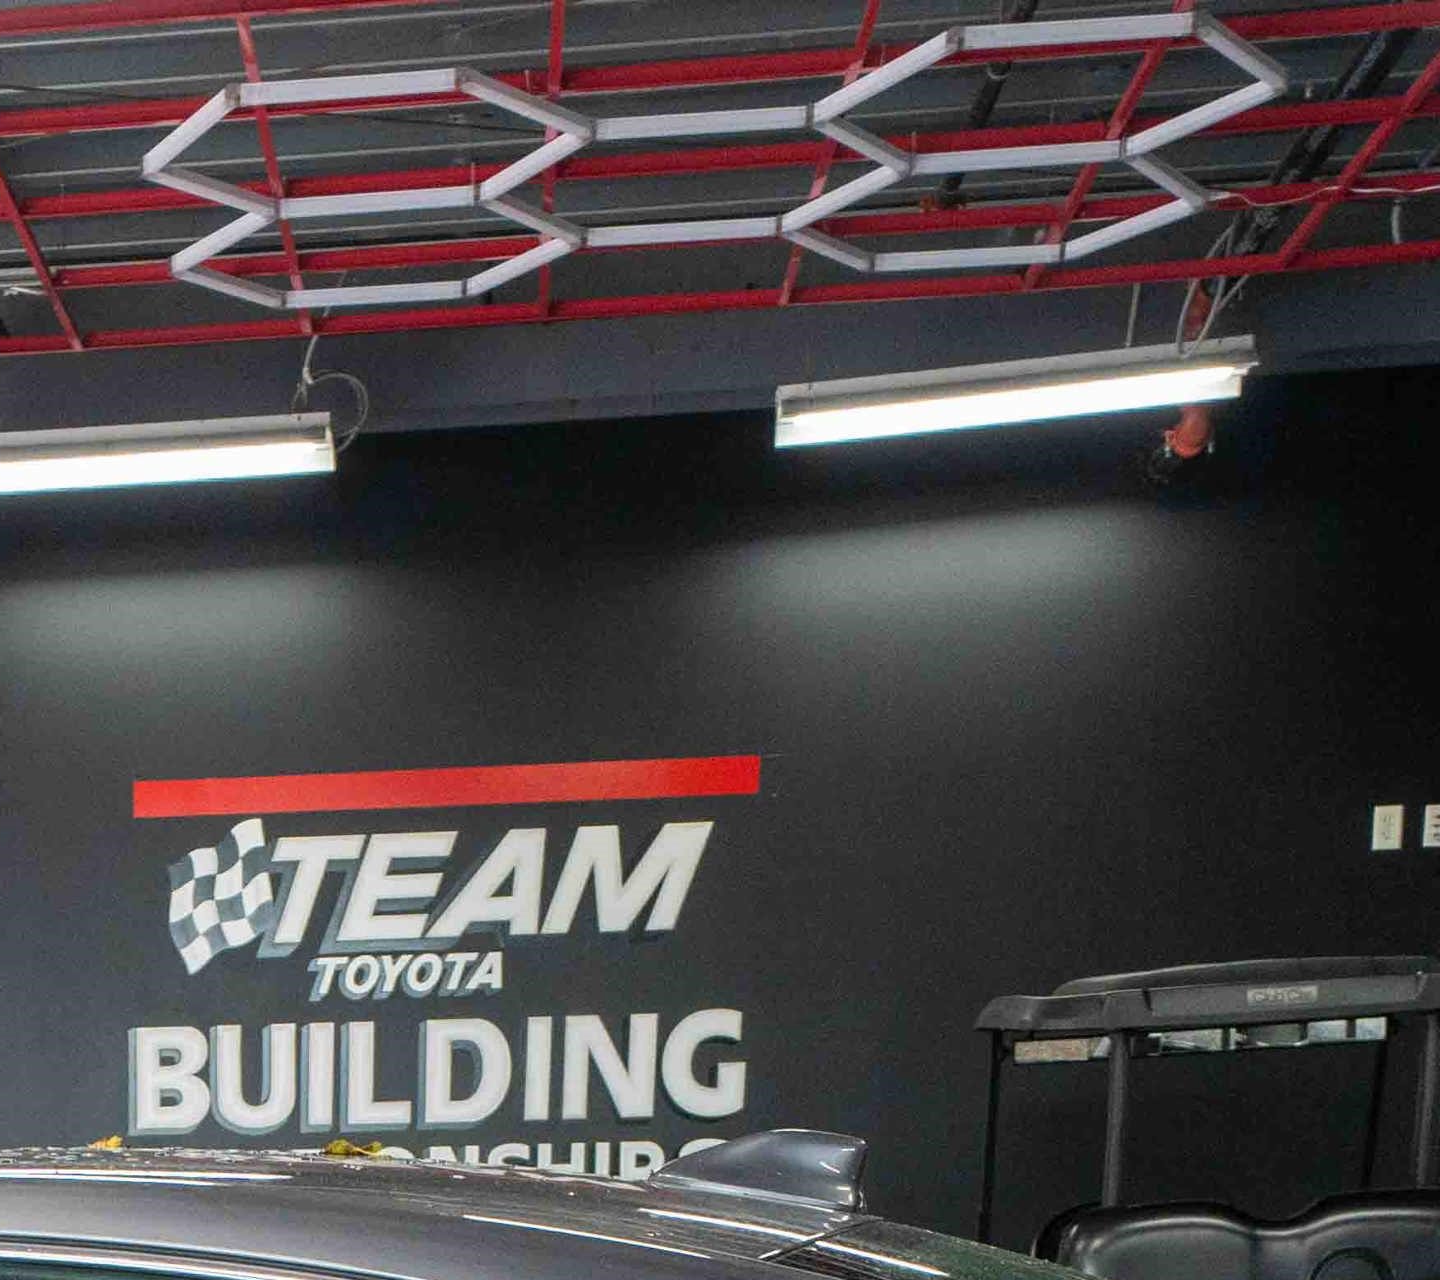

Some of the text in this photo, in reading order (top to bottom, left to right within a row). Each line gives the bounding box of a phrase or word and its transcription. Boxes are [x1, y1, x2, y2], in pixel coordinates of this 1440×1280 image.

[258, 820, 714, 957] TEAM
[309, 950, 504, 1000] TOYOTA
[128, 1008, 749, 1136] BUILDING
